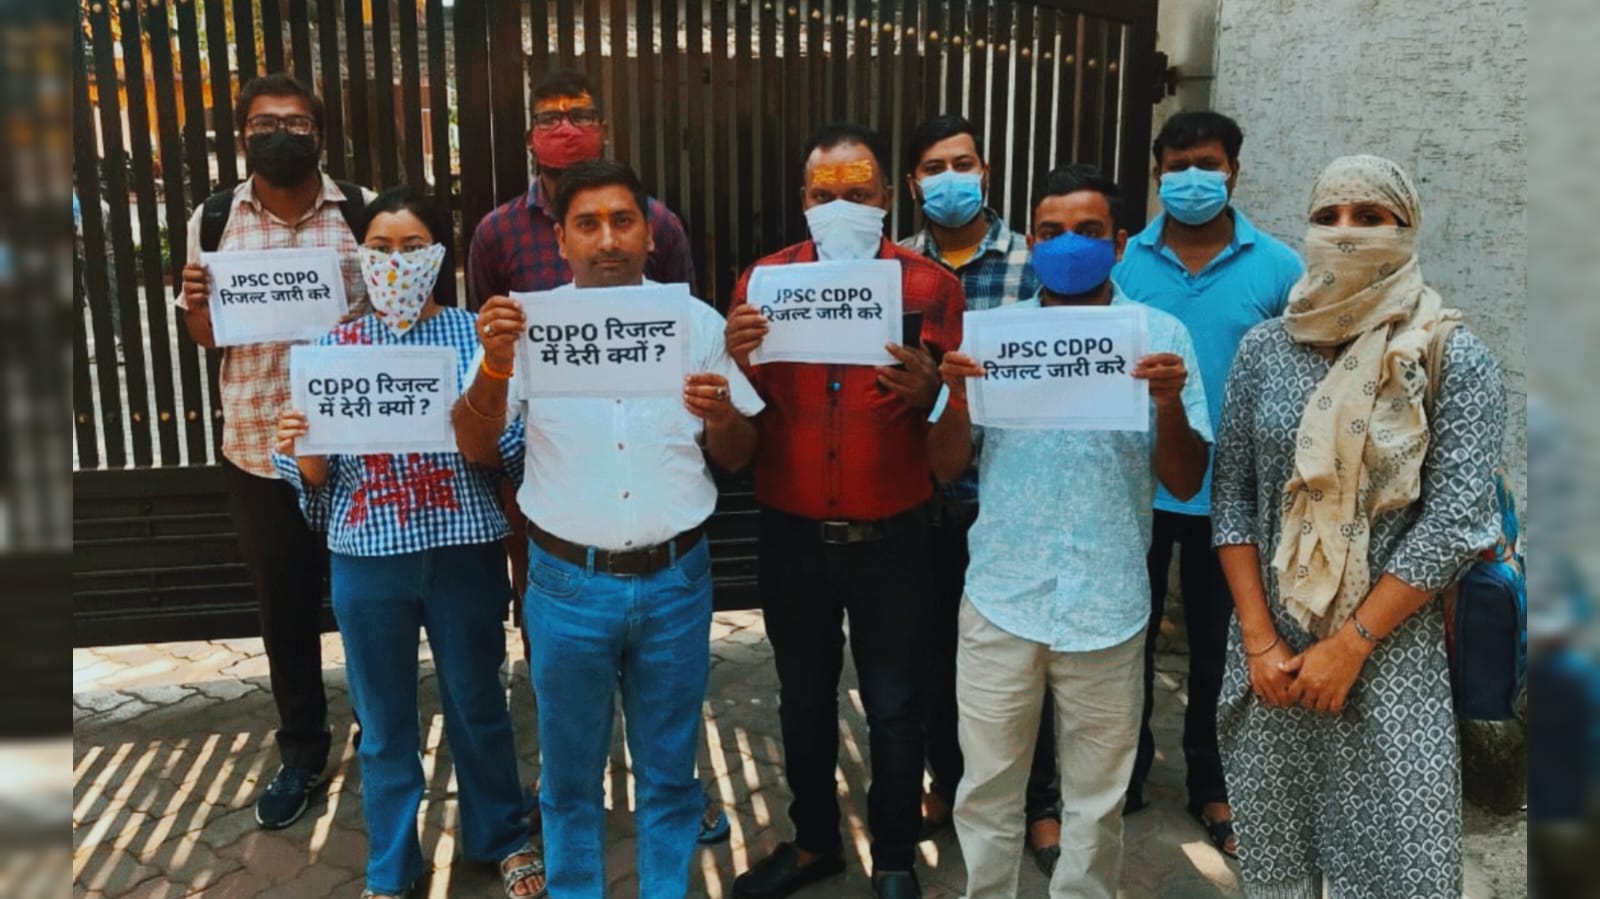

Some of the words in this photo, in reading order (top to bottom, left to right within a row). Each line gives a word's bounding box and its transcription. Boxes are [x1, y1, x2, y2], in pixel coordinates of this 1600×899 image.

[230, 271, 270, 288] JPSC
[273, 270, 319, 286] CDPO
[220, 288, 266, 306] रिजल्ट
[271, 286, 304, 302] जारी
[308, 284, 331, 300] करे
[773, 287, 817, 305] JPSC
[821, 287, 873, 303] CDPO
[816, 303, 852, 321] जारी
[857, 302, 883, 321] करे
[528, 323, 598, 343] CDPO
[605, 317, 676, 340] रिजल्ट
[541, 343, 560, 365] में
[565, 343, 600, 366] देरी
[607, 340, 649, 364] क्यों
[655, 344, 666, 362] ?
[997, 340, 1048, 359] JPSC
[1053, 337, 1113, 356] CDPO
[983, 360, 1042, 380] रिजल्ट
[1046, 357, 1090, 378] जारी
[1096, 355, 1127, 376] करे
[308, 377, 371, 396] CDPO
[376, 372, 440, 395] रिजल्ट
[319, 396, 335, 417] में
[341, 397, 372, 417] देरी
[378, 395, 417, 416] क्यों
[420, 398, 431, 416] ?
